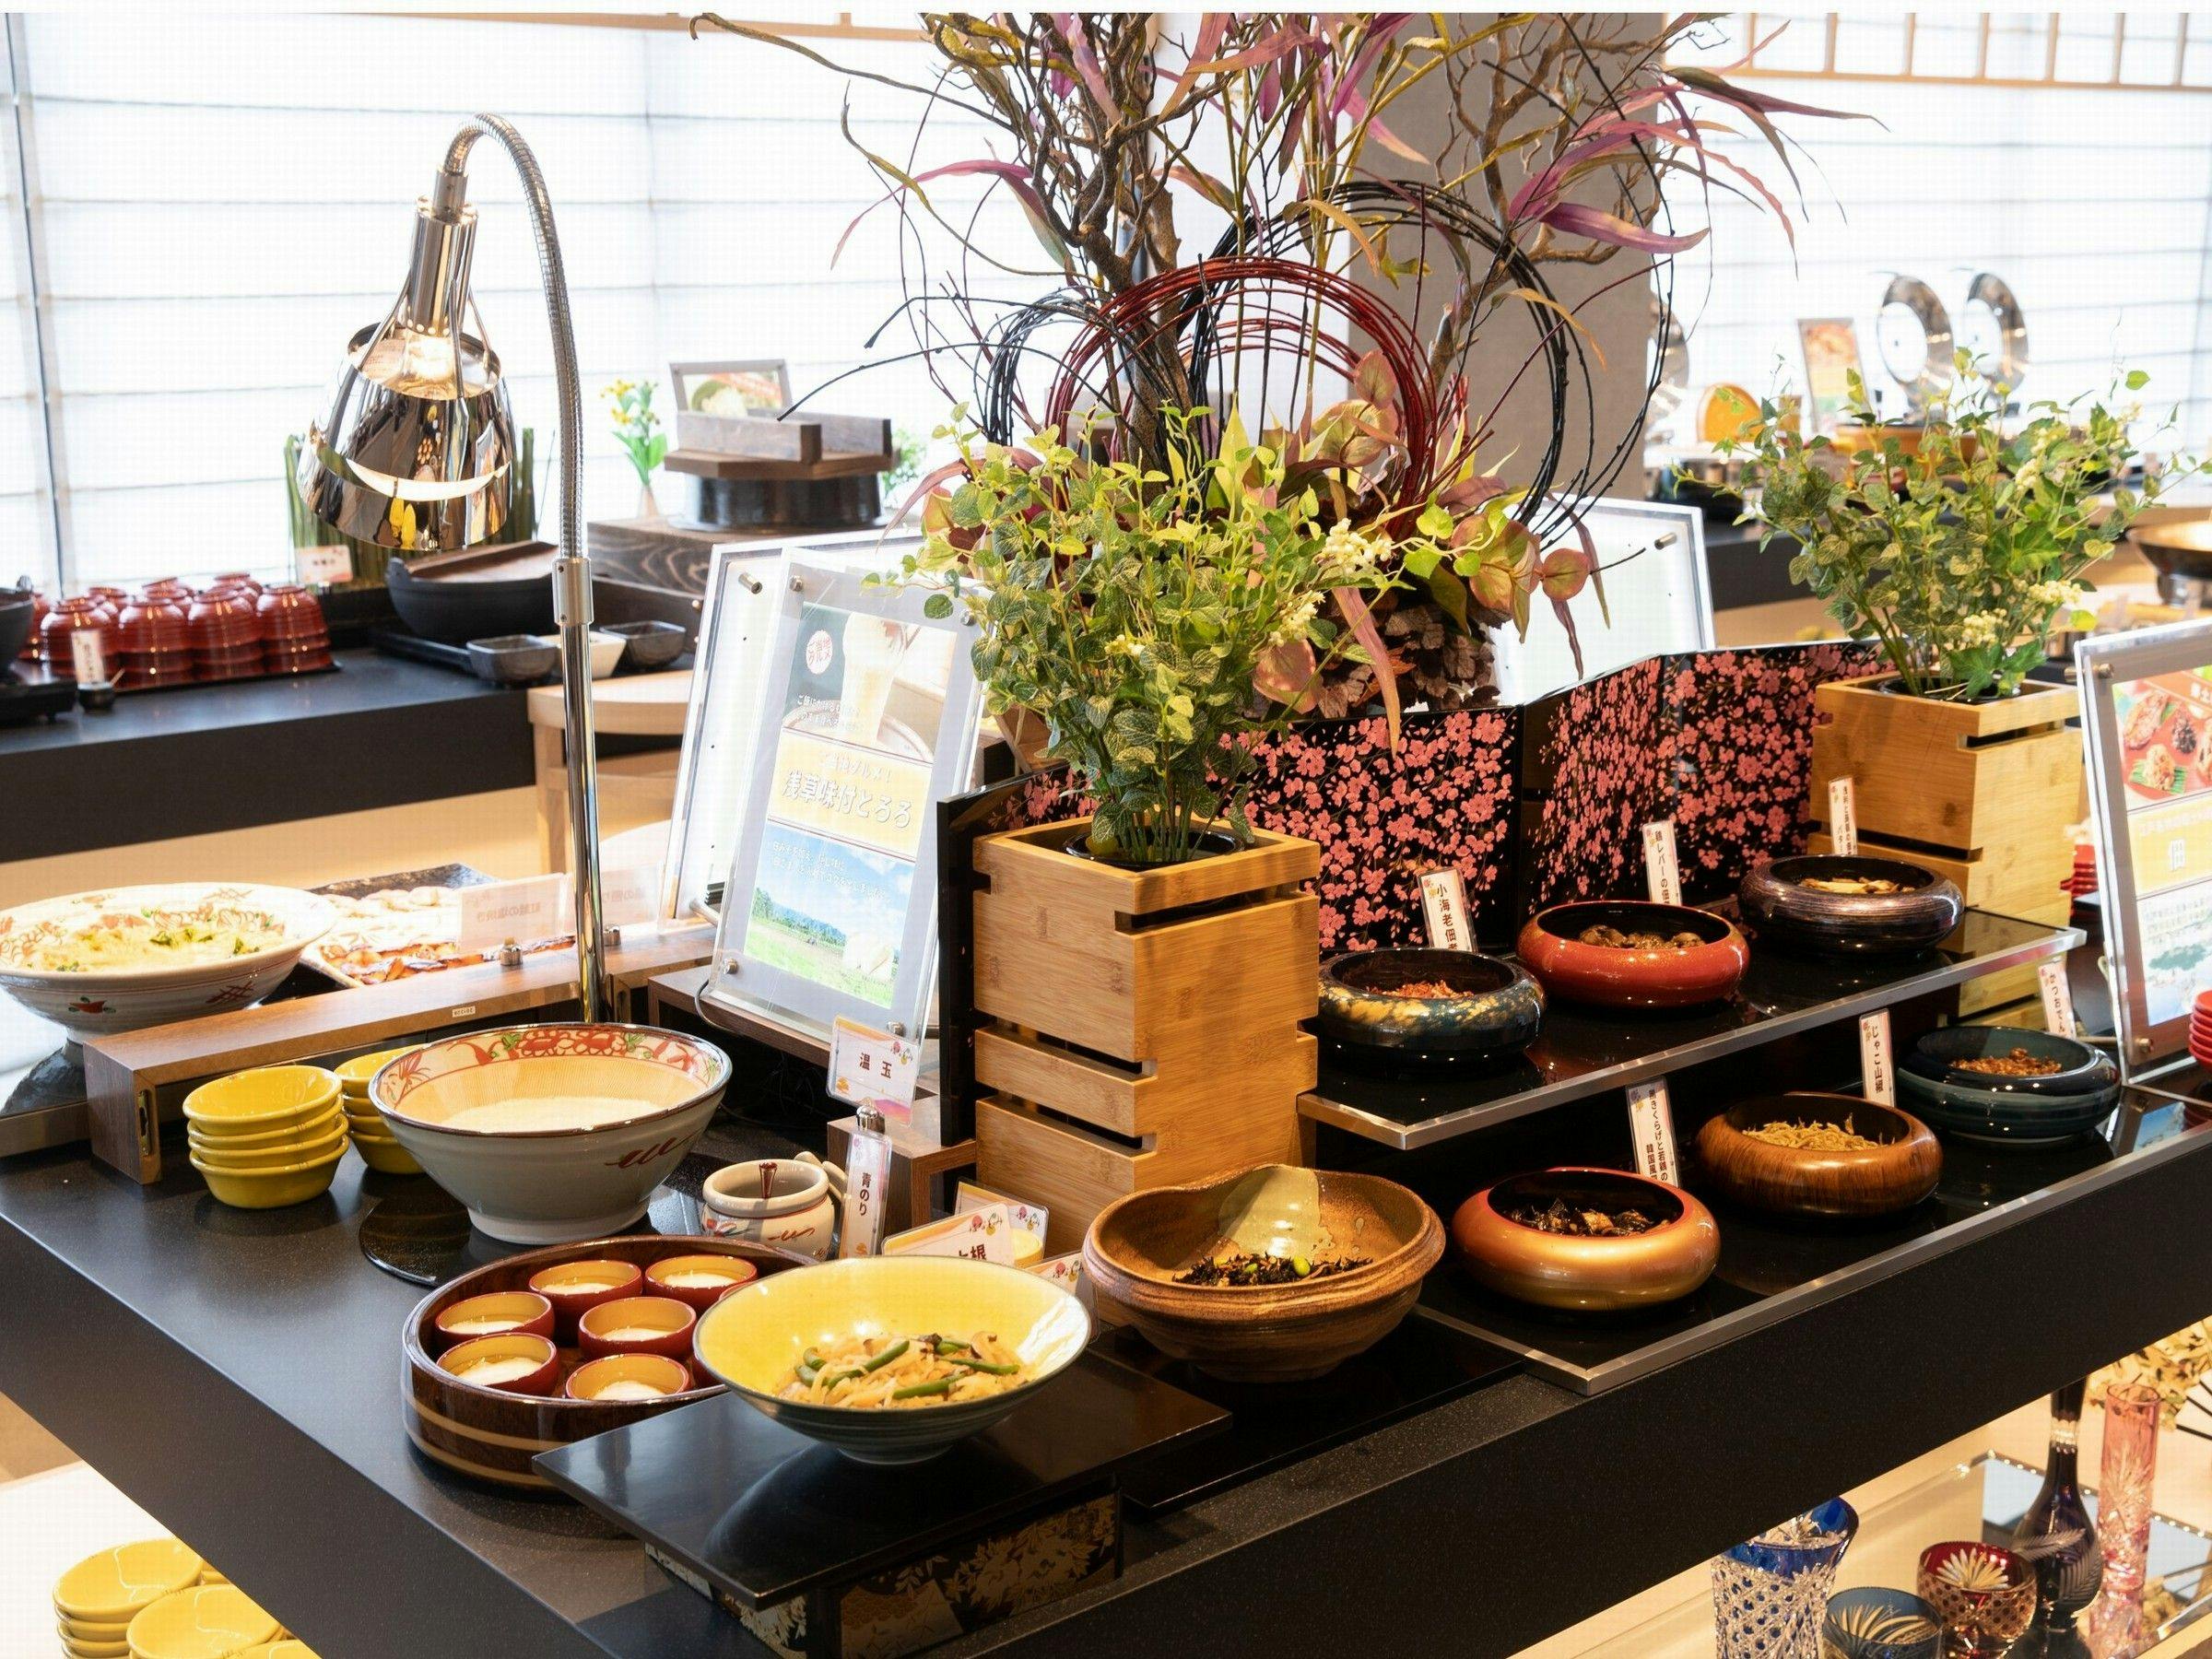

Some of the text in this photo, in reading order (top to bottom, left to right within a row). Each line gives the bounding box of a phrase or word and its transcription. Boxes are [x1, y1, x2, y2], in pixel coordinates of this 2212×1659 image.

[783, 770, 912, 829] 浅草味付とろろ
[859, 1052, 892, 1079] 温玉
[859, 1172, 872, 1217] 青のり
